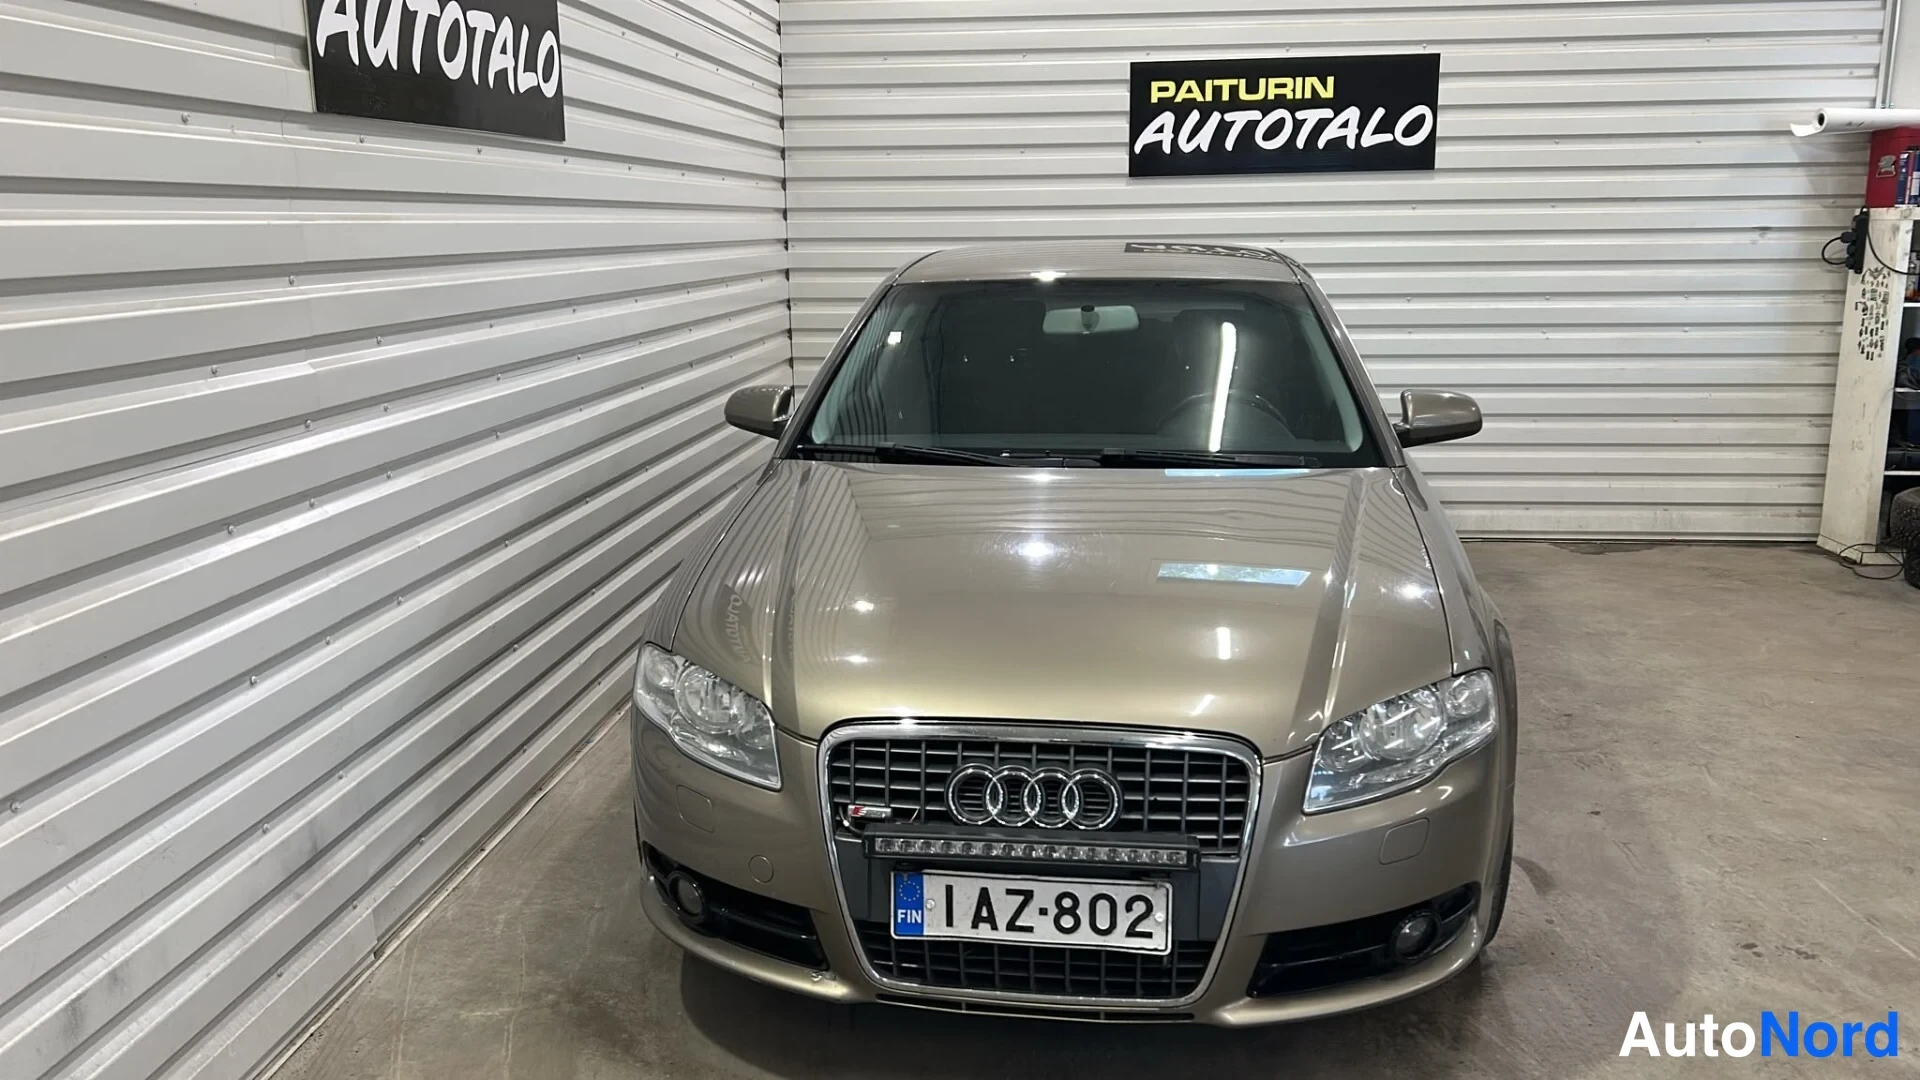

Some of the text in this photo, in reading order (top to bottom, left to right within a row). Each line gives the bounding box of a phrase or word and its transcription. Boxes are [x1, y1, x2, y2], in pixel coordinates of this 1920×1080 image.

[316, 0, 560, 98] AUTOTALO
[1150, 75, 1335, 103] PAITURIN
[1134, 104, 1434, 155] AUTOTALO
[897, 909, 922, 924] FIN
[944, 884, 1154, 939] IAZ-802
